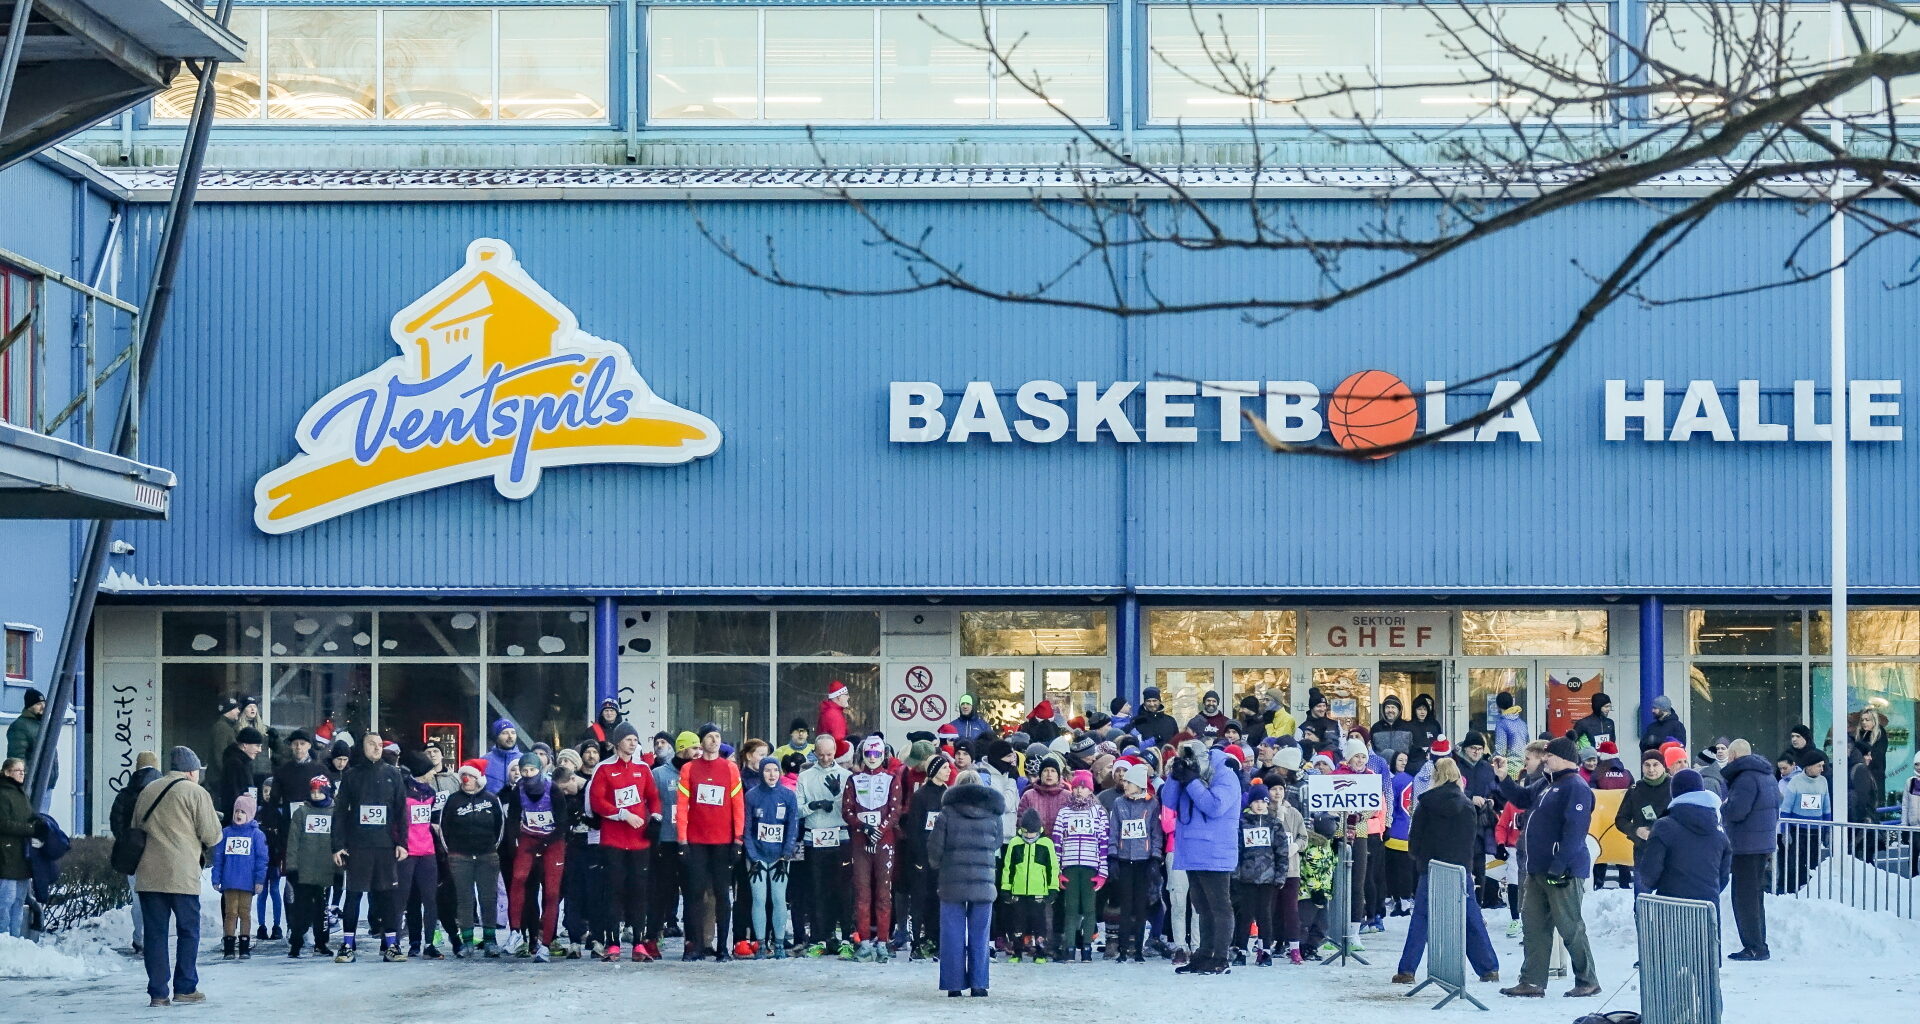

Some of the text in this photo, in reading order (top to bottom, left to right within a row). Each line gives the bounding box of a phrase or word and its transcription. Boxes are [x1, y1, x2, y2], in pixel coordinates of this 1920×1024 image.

[1605, 379, 1903, 442] HALLE
[311, 353, 633, 483] Ventspils
[1352, 616, 1406, 626] SEKTORI
[623, 788, 635, 801] 27
[710, 788, 716, 798] 1
[1311, 792, 1380, 809] STARTS
[1810, 796, 1816, 804] 7
[368, 808, 382, 818] 59
[416, 808, 430, 817] 135
[537, 813, 545, 822] 8
[314, 817, 328, 827] 39
[863, 814, 876, 824] 13
[1073, 819, 1092, 828] 113
[761, 825, 781, 836] 103
[1126, 821, 1143, 832] 114
[821, 831, 835, 840] 22
[1249, 829, 1268, 839] 112
[231, 839, 249, 849] 130
